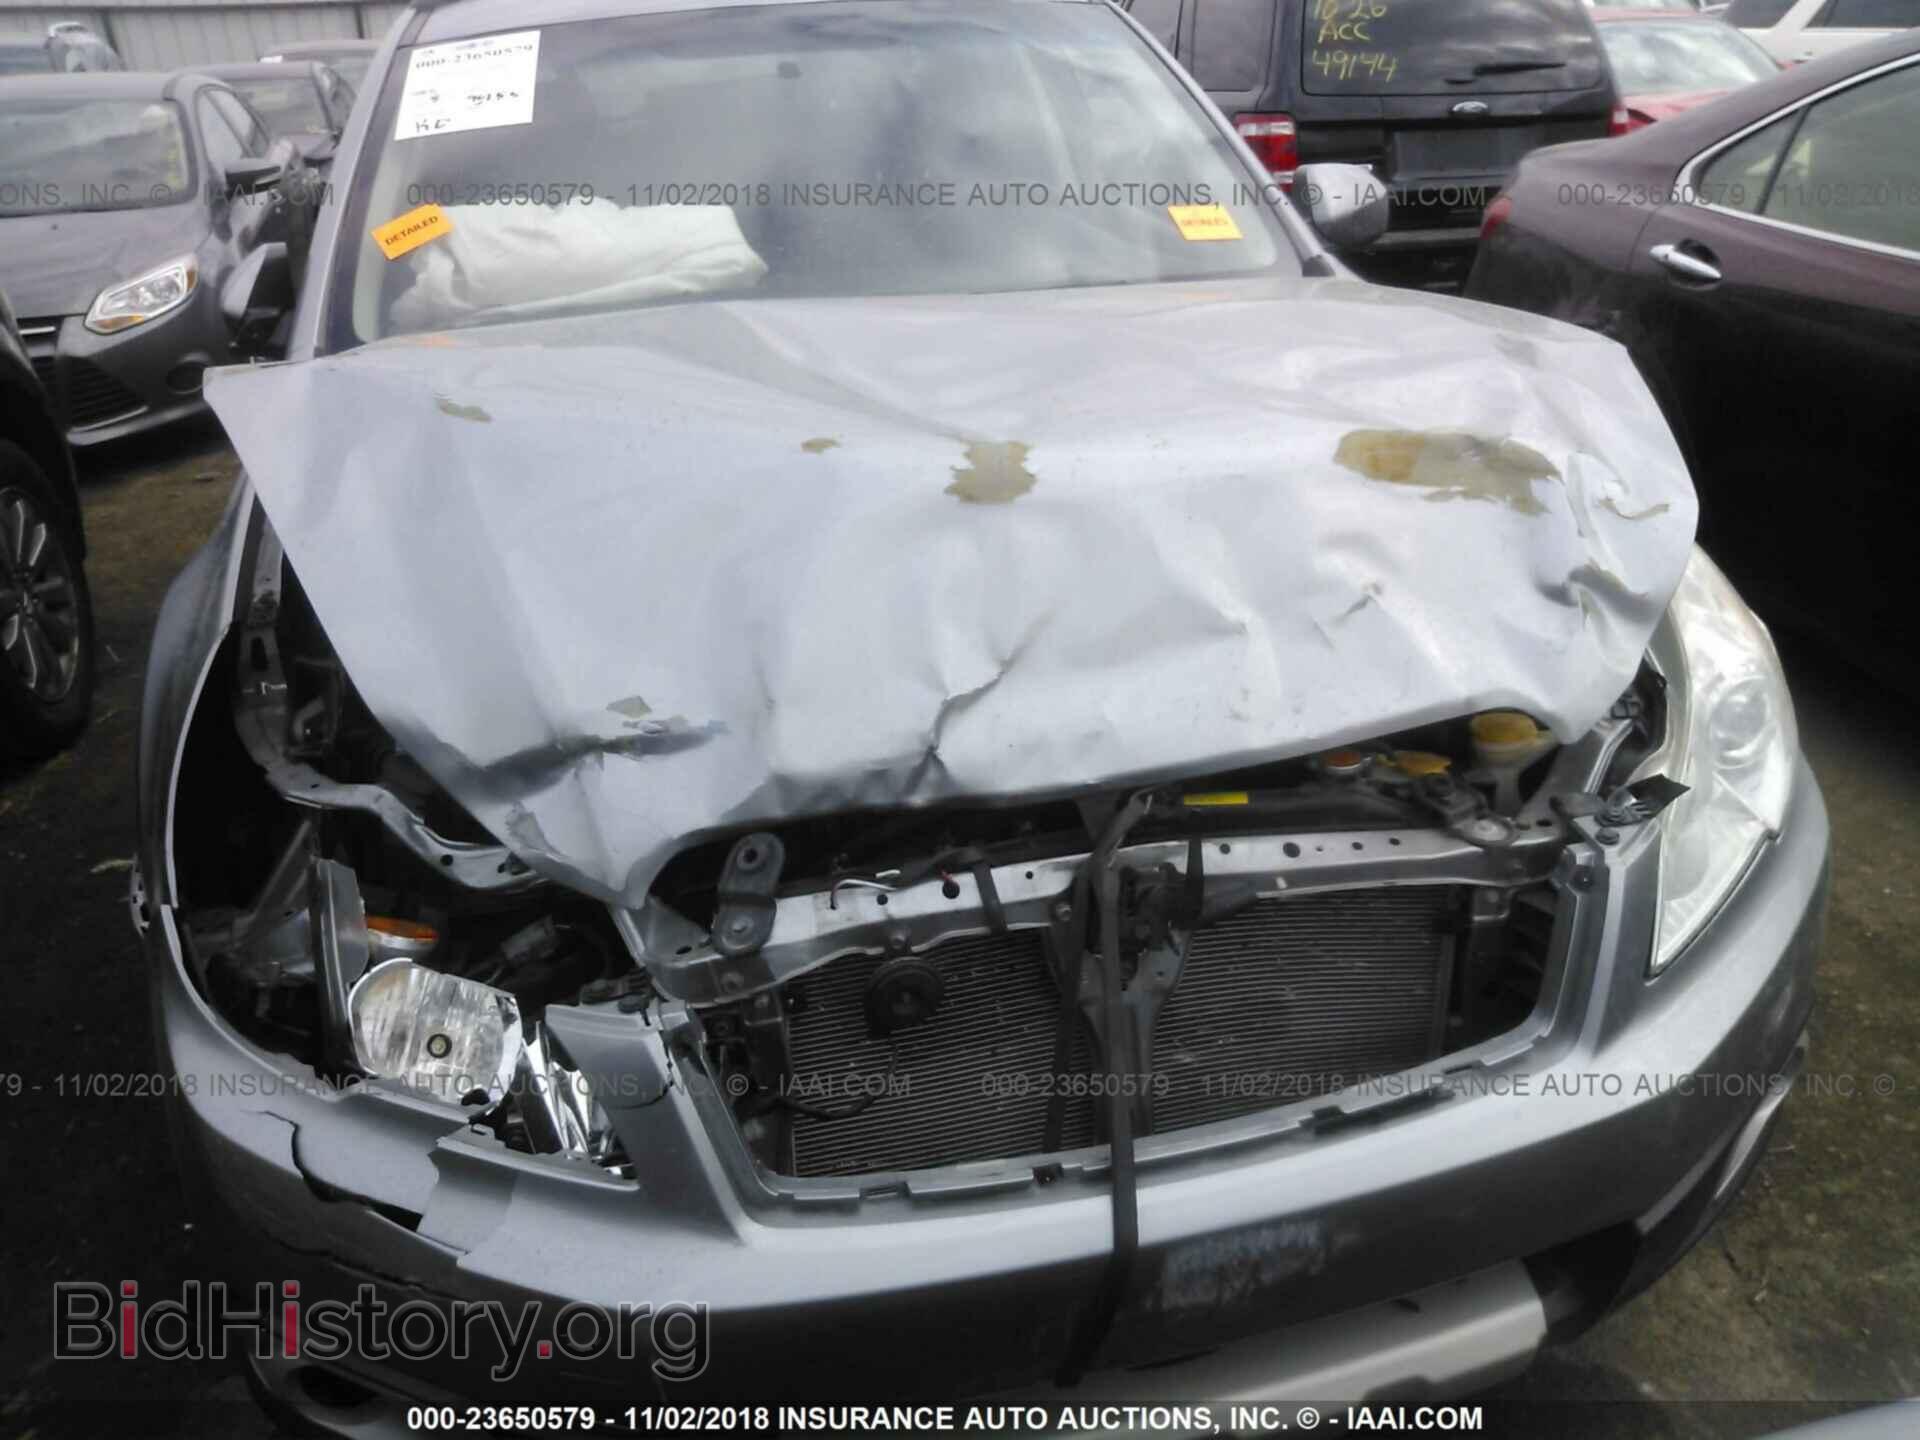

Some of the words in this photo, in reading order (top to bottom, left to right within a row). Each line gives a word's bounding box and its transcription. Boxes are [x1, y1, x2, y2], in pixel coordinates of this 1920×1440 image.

[1317, 22, 1371, 44] ACC
[1311, 50, 1399, 83] 49144
[385, 216, 439, 245] DETAILED
